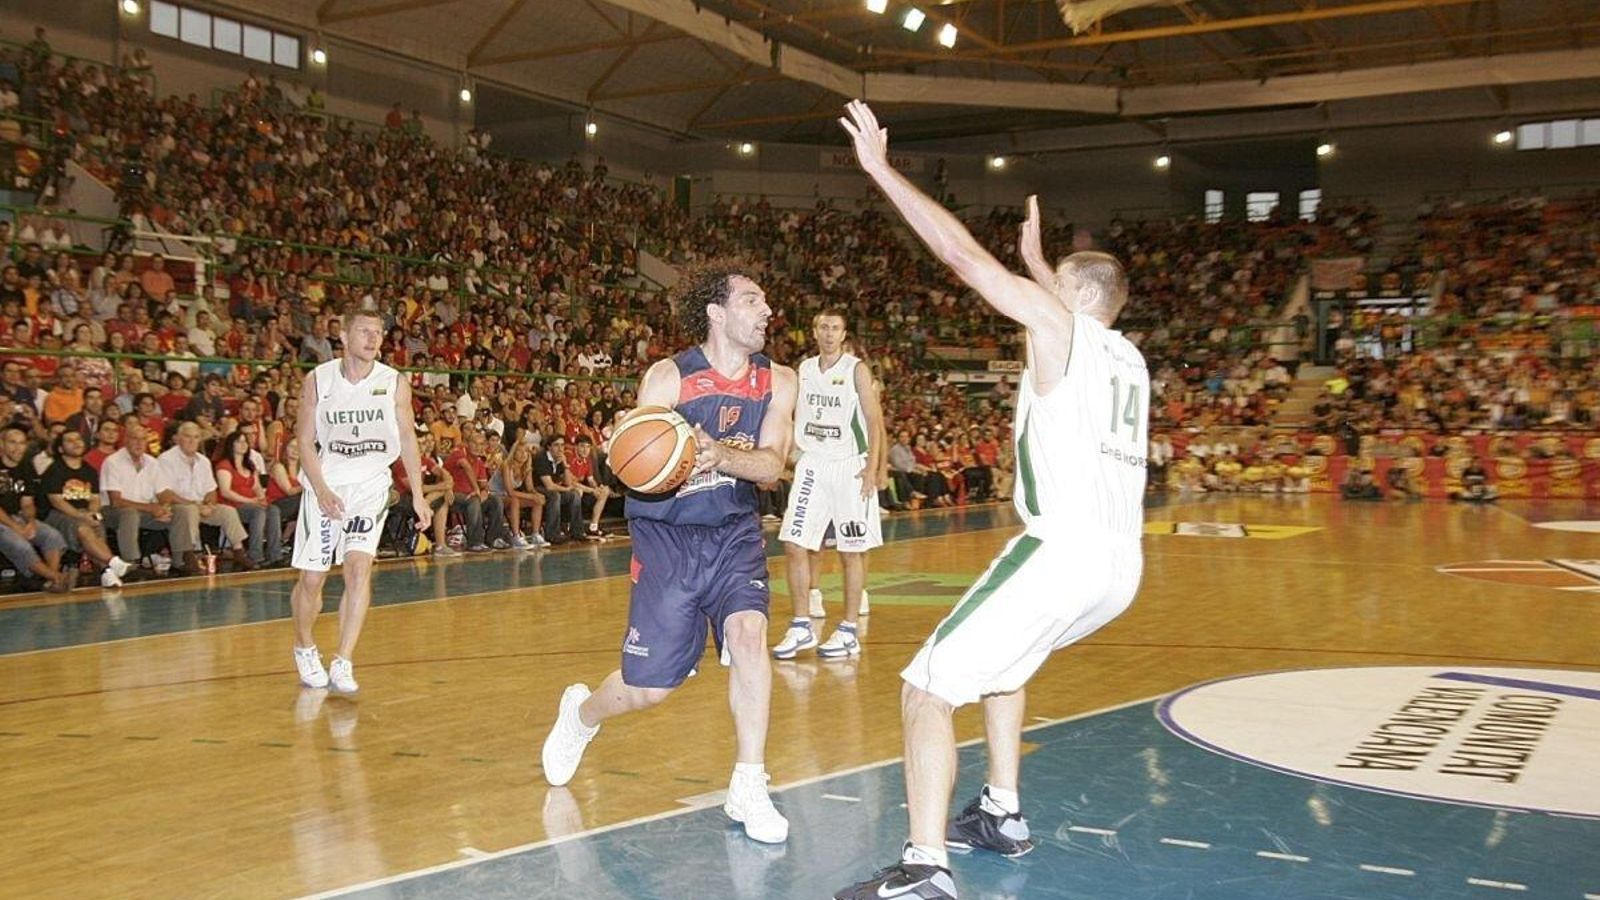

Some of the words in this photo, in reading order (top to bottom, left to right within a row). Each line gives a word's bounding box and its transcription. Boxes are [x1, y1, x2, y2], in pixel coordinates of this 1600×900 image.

[325, 408, 385, 425] LIETUVA
[351, 425, 360, 438] 4
[815, 407, 824, 421] 5
[1109, 374, 1141, 443] 14
[790, 468, 815, 538] SAMSUNG
[1335, 685, 1489, 772] VALENCIANA
[1437, 693, 1566, 785] COMUNITAT
